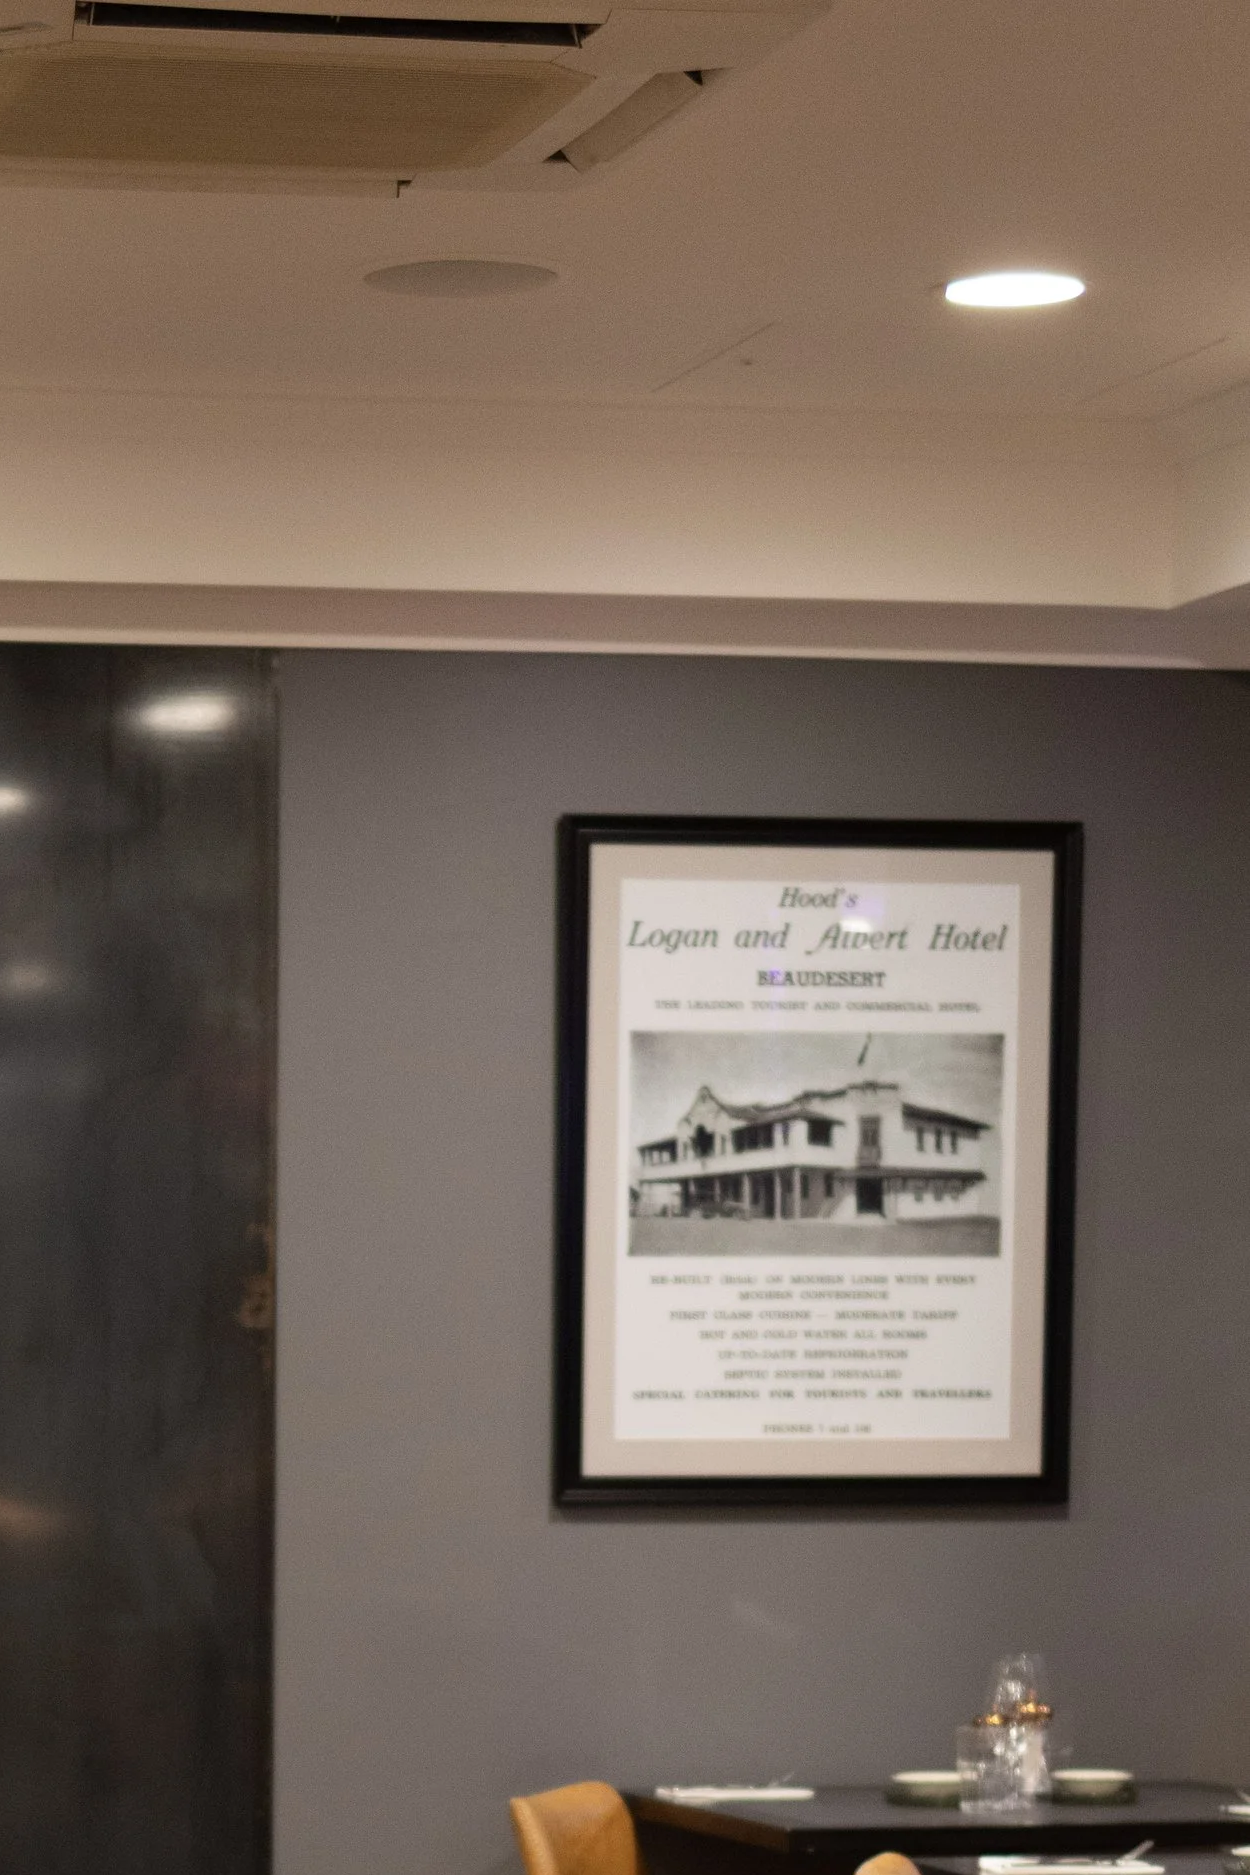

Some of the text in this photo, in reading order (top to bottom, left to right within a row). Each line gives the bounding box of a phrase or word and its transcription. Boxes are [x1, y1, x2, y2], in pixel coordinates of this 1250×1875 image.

[778, 886, 858, 909] Hood's
[626, 919, 719, 954] Logan
[733, 921, 791, 949] and
[928, 923, 1009, 952] Hotel
[756, 970, 887, 989] BEAUDESERT
[813, 1001, 841, 1012] AND
